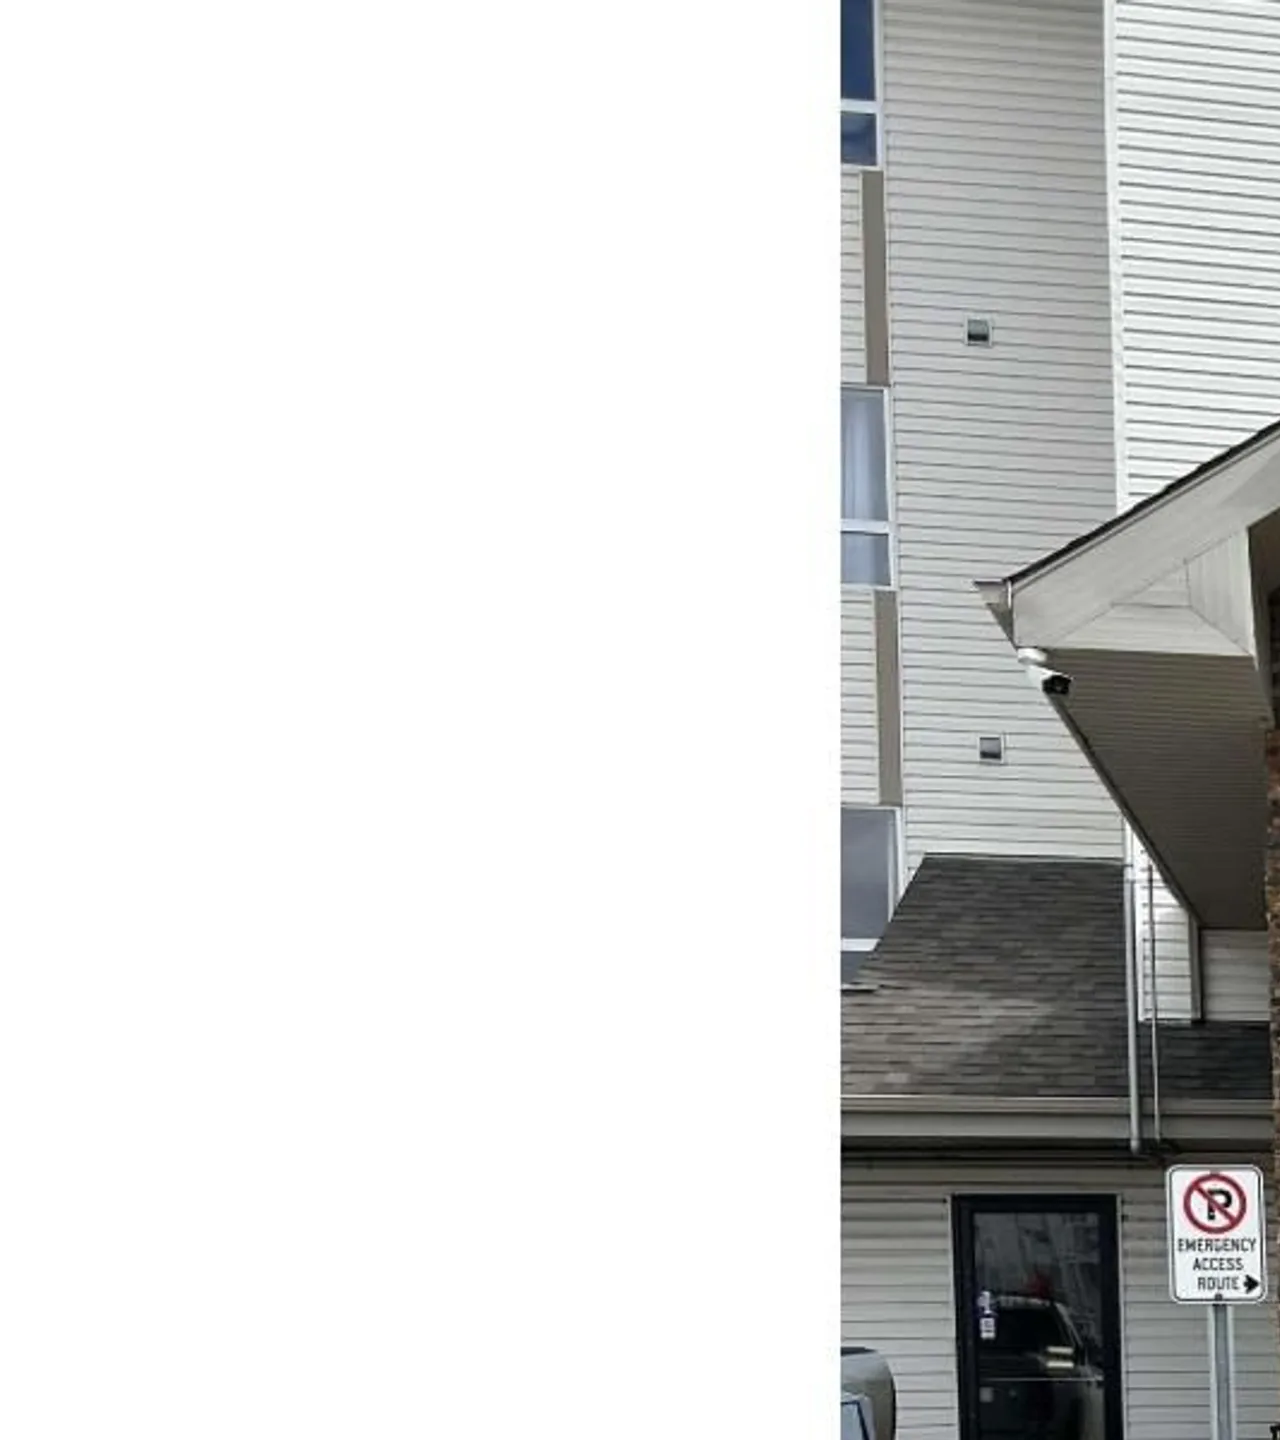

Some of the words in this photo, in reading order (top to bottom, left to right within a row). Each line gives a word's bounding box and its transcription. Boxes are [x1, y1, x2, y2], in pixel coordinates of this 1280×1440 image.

[1178, 1238, 1257, 1253] EMERGENCY
[1193, 1258, 1244, 1271] ACCESS
[1198, 1277, 1240, 1290] ROUTE
